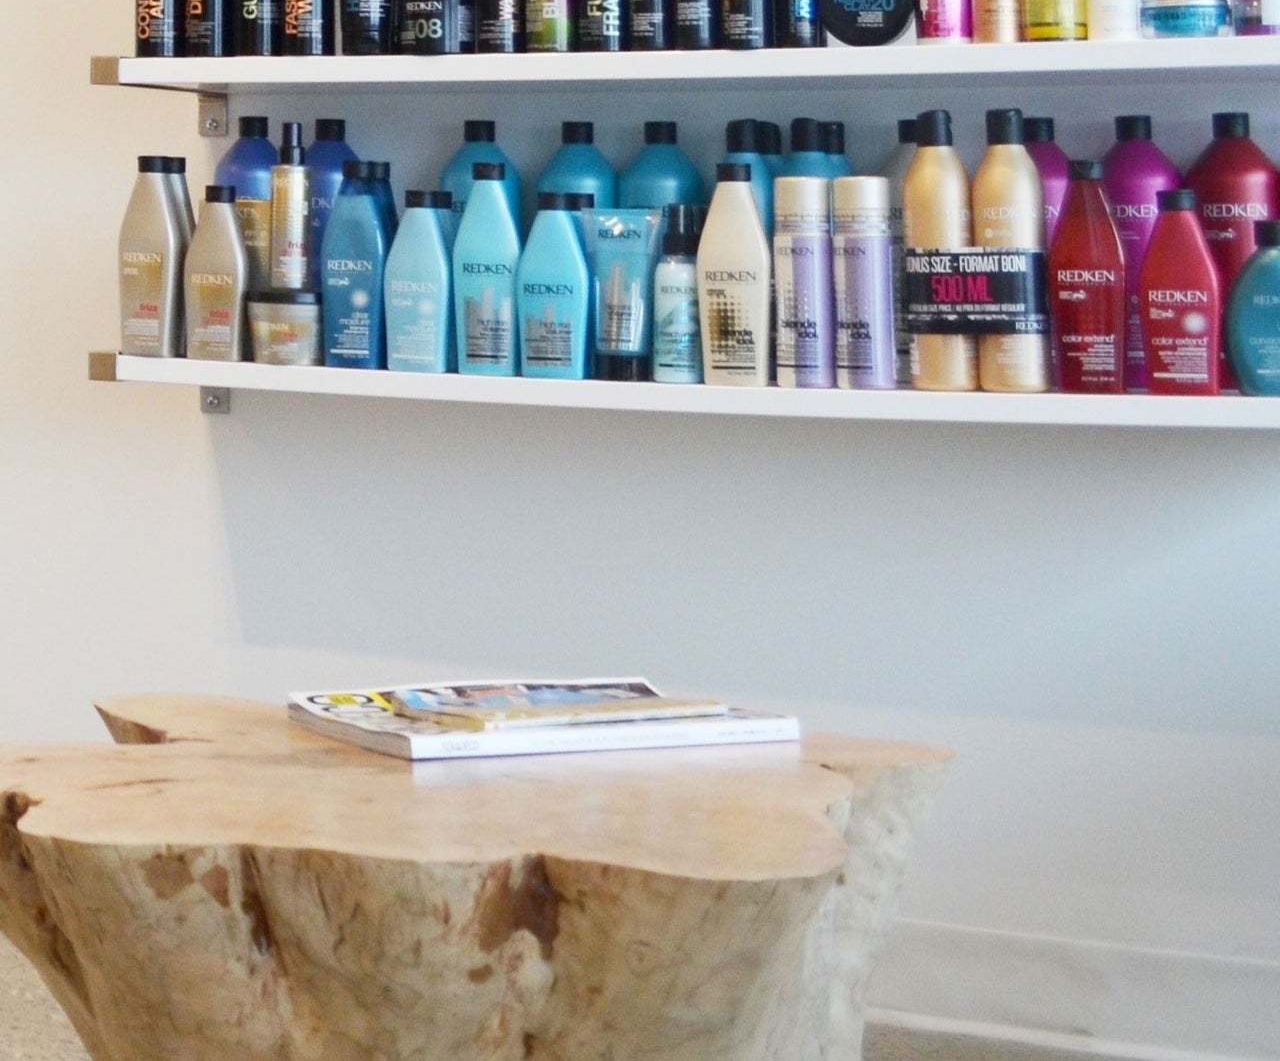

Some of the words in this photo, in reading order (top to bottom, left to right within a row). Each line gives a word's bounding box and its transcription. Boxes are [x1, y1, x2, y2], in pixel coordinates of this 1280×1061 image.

[406, 1, 443, 12] REDKEN
[415, 18, 443, 39] 08
[1113, 204, 1158, 218] EDKEN
[1203, 204, 1268, 218] REDKEN
[122, 251, 162, 263] REDKEN
[327, 259, 372, 270] REDKEN
[463, 263, 512, 274] REDKEN
[930, 255, 952, 273] SIZE
[959, 255, 1000, 273] FORMAT
[1001, 254, 1026, 272] BONI
[191, 273, 233, 285] REDKEN
[705, 271, 756, 281] REDKEN
[1057, 270, 1114, 282] REDKEN
[391, 281, 438, 292] REDKEN
[523, 283, 574, 295] REDKEN
[931, 275, 963, 302] 500
[967, 275, 993, 302] ML
[1148, 290, 1208, 302] REDKEN
[1062, 335, 1082, 343] color
[1084, 334, 1115, 343] extend
[1151, 337, 1173, 346] color
[1175, 337, 1208, 346] extend
